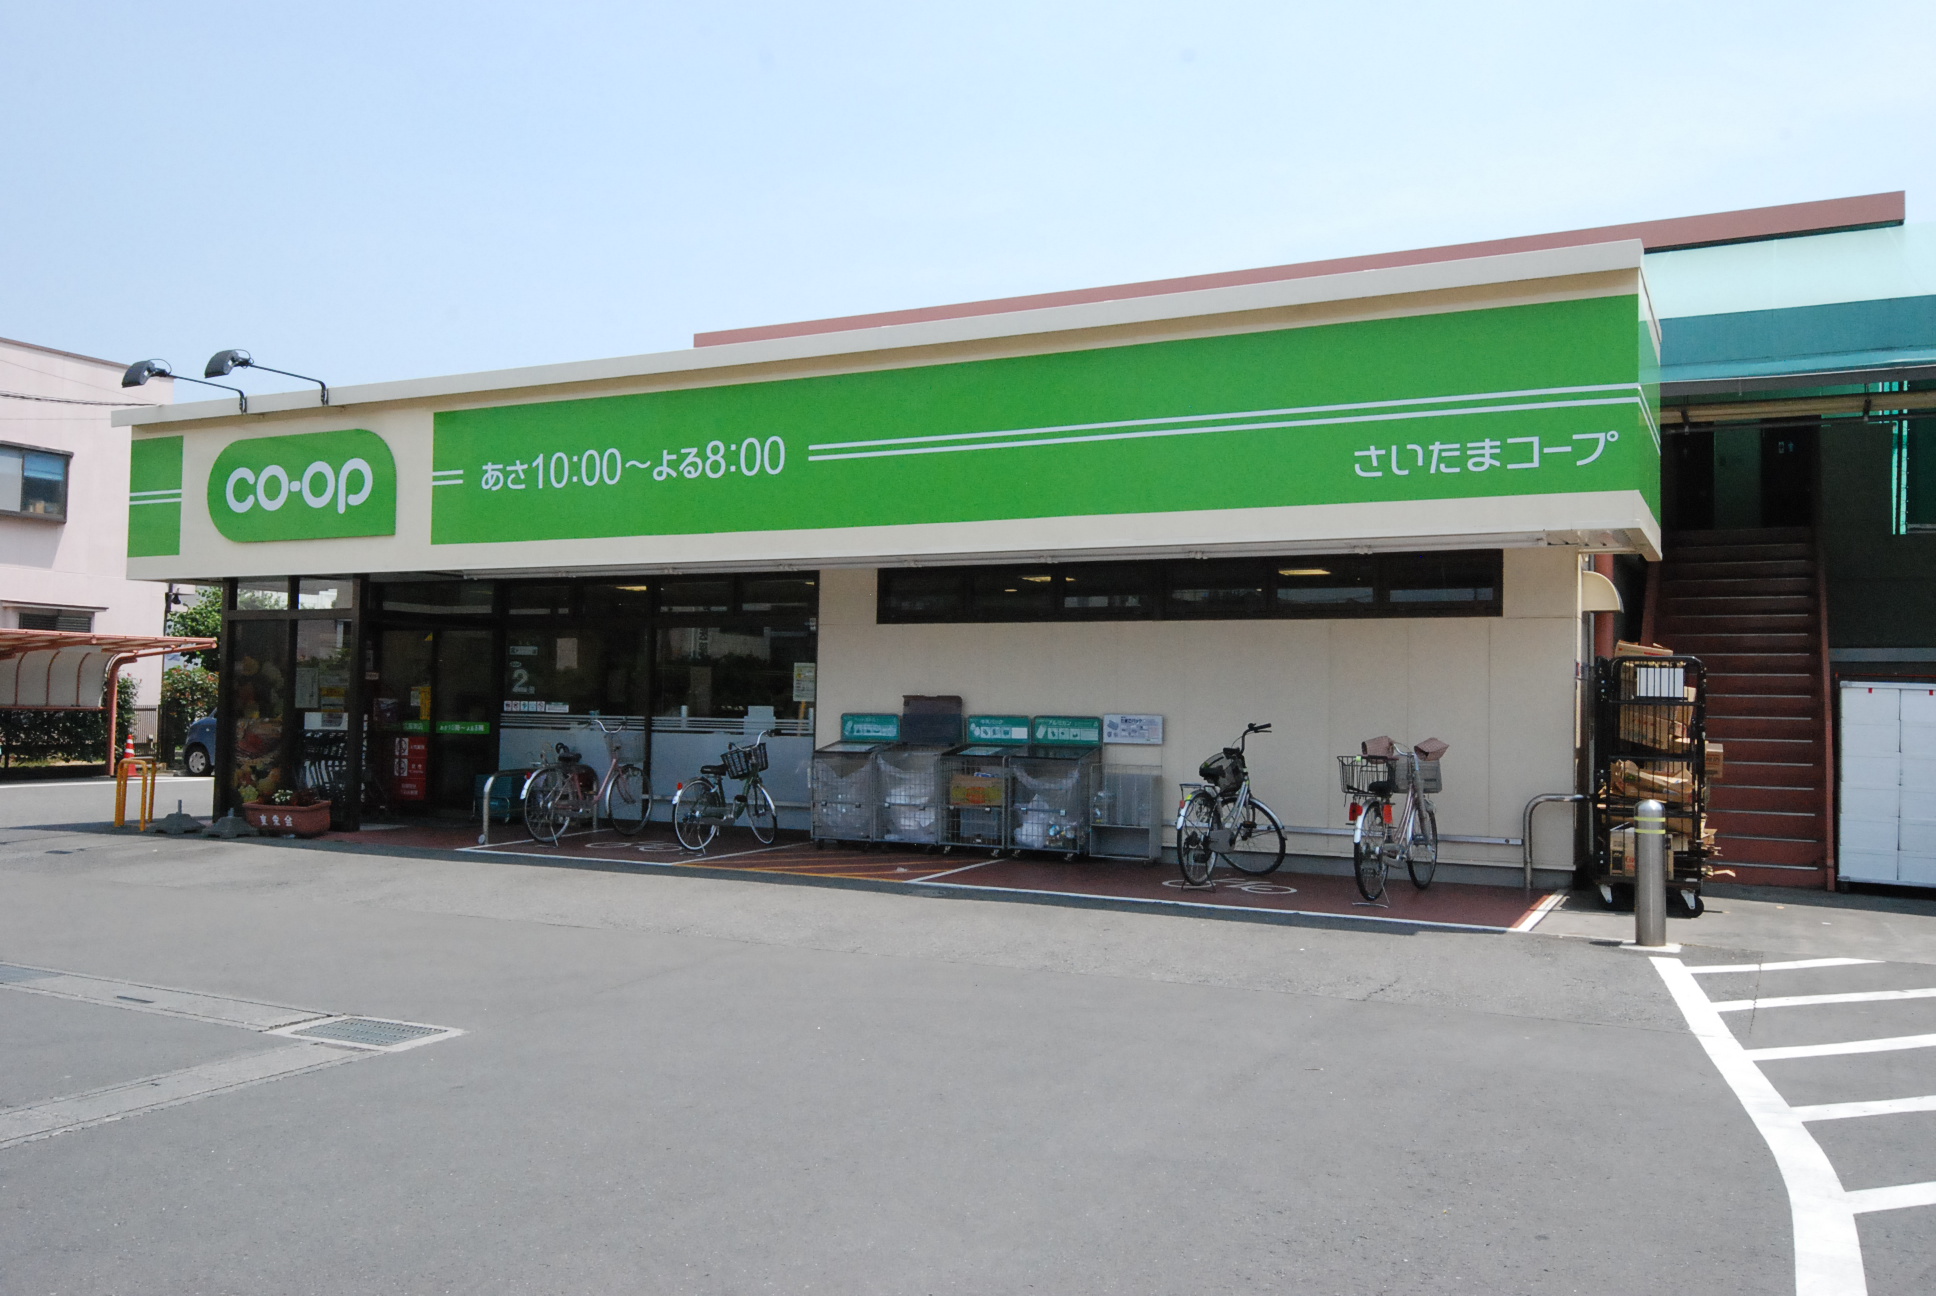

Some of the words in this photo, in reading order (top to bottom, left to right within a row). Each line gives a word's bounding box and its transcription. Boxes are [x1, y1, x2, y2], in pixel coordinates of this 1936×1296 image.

[1354, 431, 1619, 477] さいたまコープ
